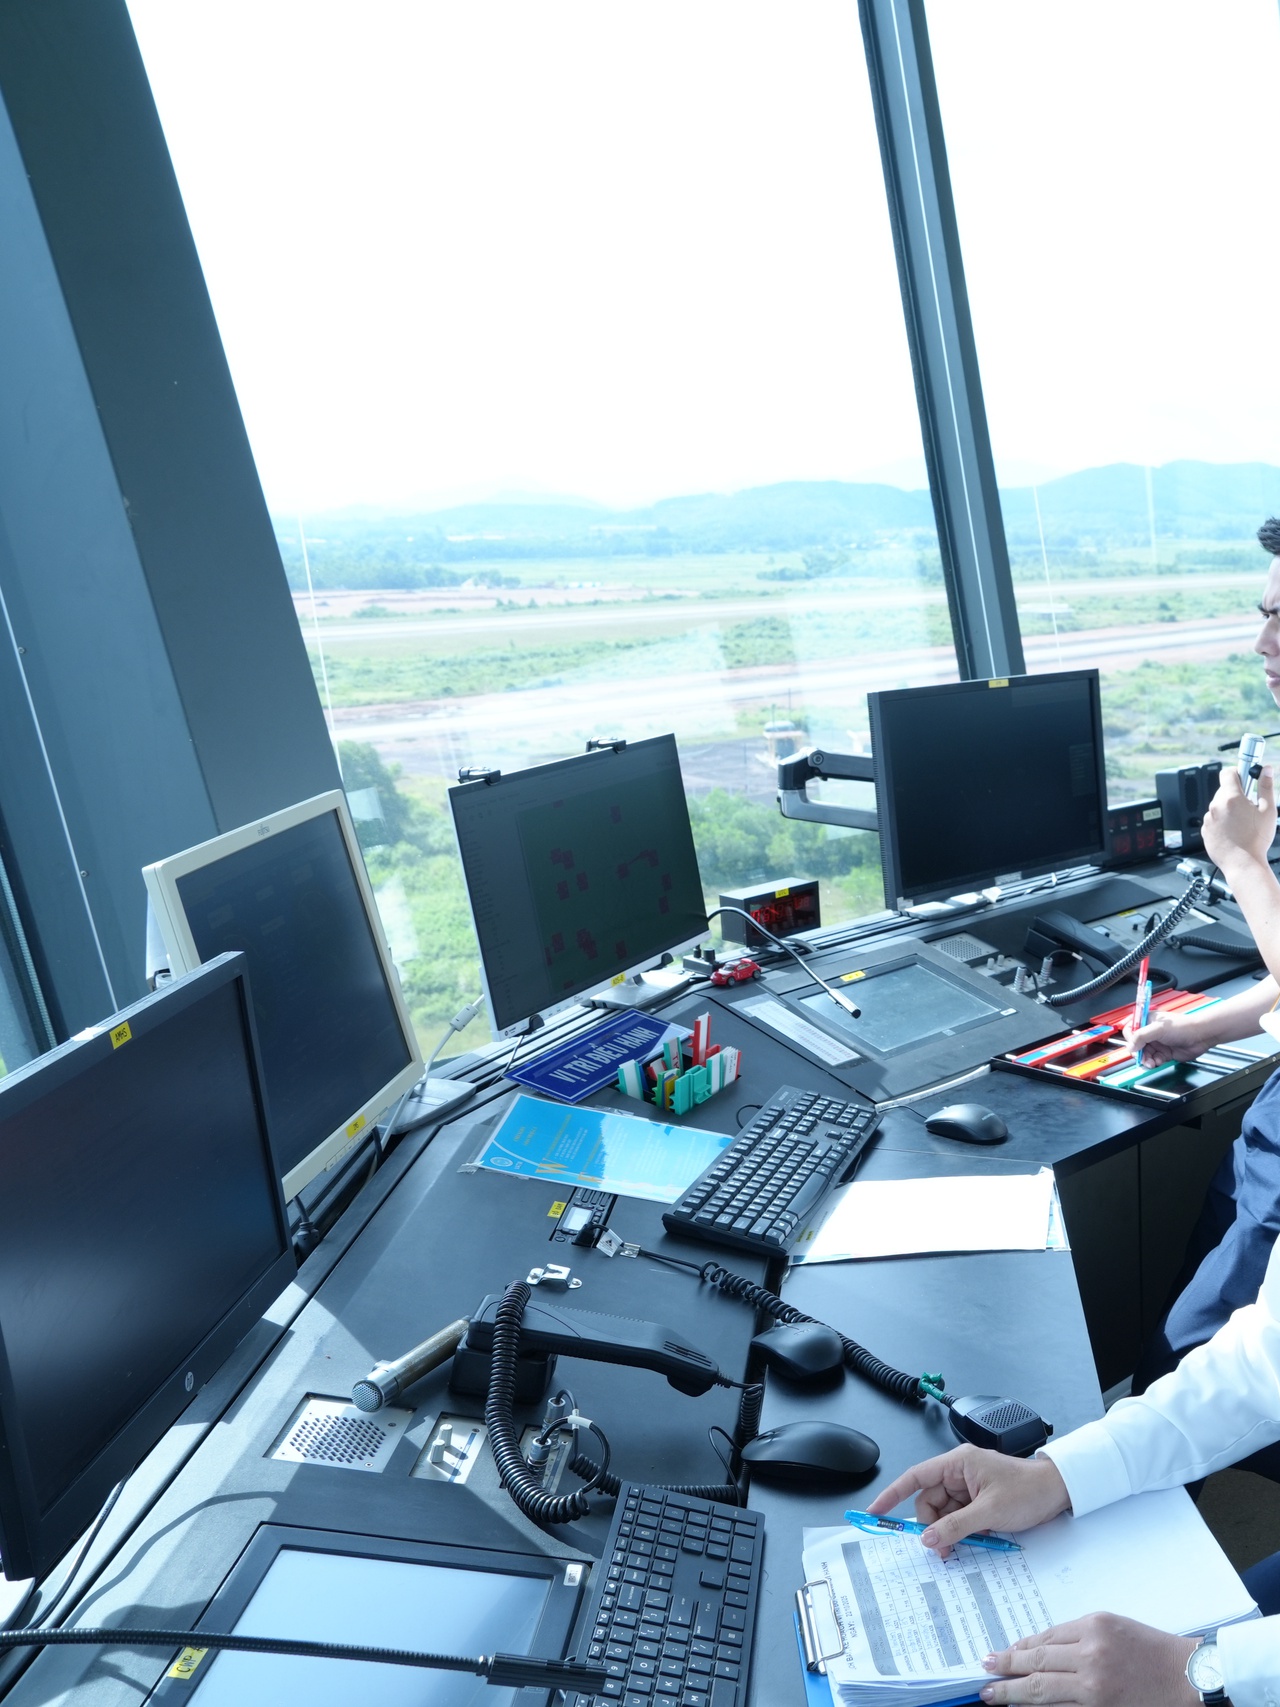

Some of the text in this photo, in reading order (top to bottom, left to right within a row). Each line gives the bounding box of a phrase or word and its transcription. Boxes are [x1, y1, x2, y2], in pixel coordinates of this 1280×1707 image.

[612, 1026, 660, 1049] HÀNH
[562, 1054, 603, 1075] TRÍ
[548, 1068, 587, 1083] VỊ
